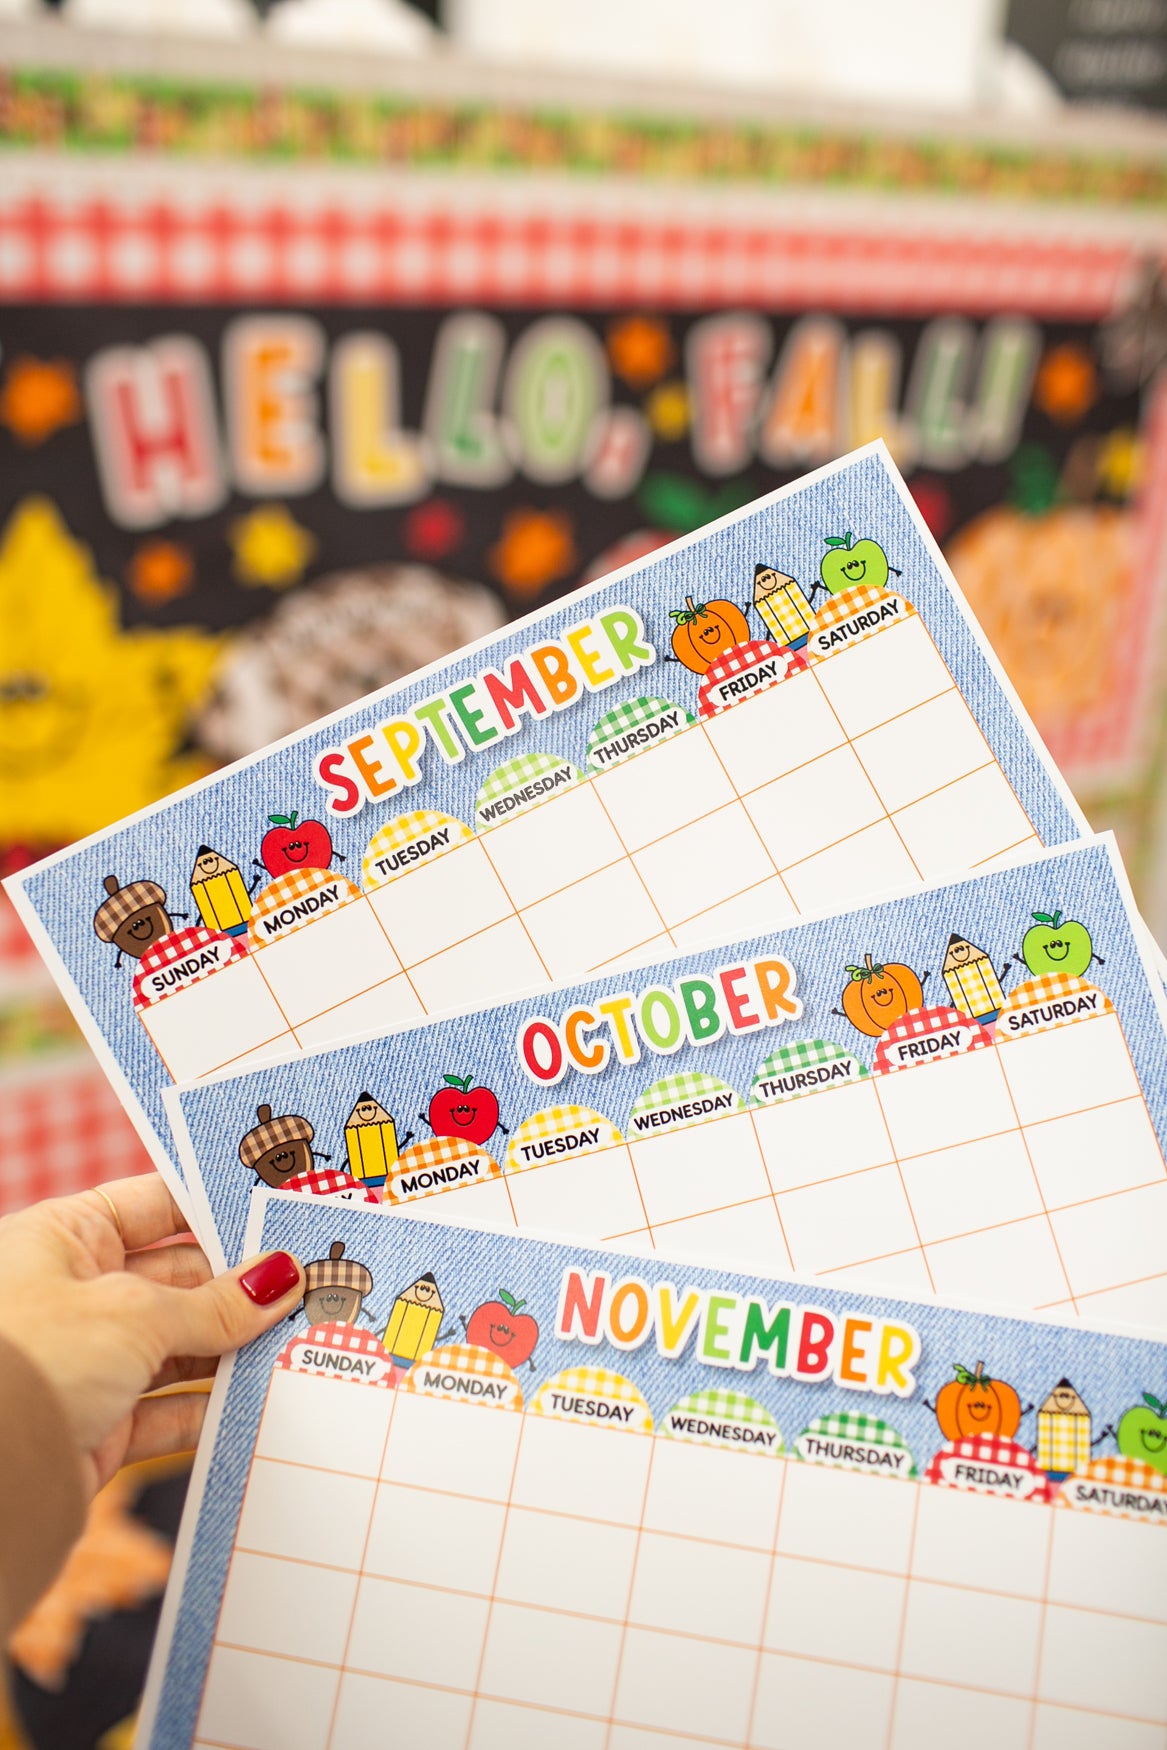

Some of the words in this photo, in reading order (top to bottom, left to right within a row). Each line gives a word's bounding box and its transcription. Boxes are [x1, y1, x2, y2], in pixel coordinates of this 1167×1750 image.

[151, 946, 222, 993] SUNDAY
[263, 885, 340, 935] MONDAY
[375, 828, 452, 877] TUESDAY
[479, 766, 575, 823] WEDNESDAY
[593, 711, 681, 765] THURSDAY
[719, 661, 779, 702] FRIDAY
[818, 600, 902, 652] SATURDAY
[319, 611, 652, 813] SEPTEMBER
[401, 1160, 481, 1195] MONDAY
[521, 1128, 601, 1162] TUESDAY
[633, 1093, 735, 1132] WEDNESDAY
[759, 1060, 853, 1098] THURSDAY
[898, 1031, 962, 1062] FRIDAY
[1008, 994, 1098, 1031] SATURDAY
[523, 960, 798, 1081] OCTOBER
[561, 1272, 915, 1390] NOVEMBER
[302, 1349, 377, 1378] SUNDAY
[424, 1371, 508, 1401] MONDAY
[551, 1394, 635, 1423] TUESDAY
[670, 1416, 777, 1448] WEDNESDAY
[806, 1438, 905, 1471] THURSDAY
[955, 1464, 1024, 1491] FRIDAY
[1075, 1484, 1167, 1515] SATURDA
